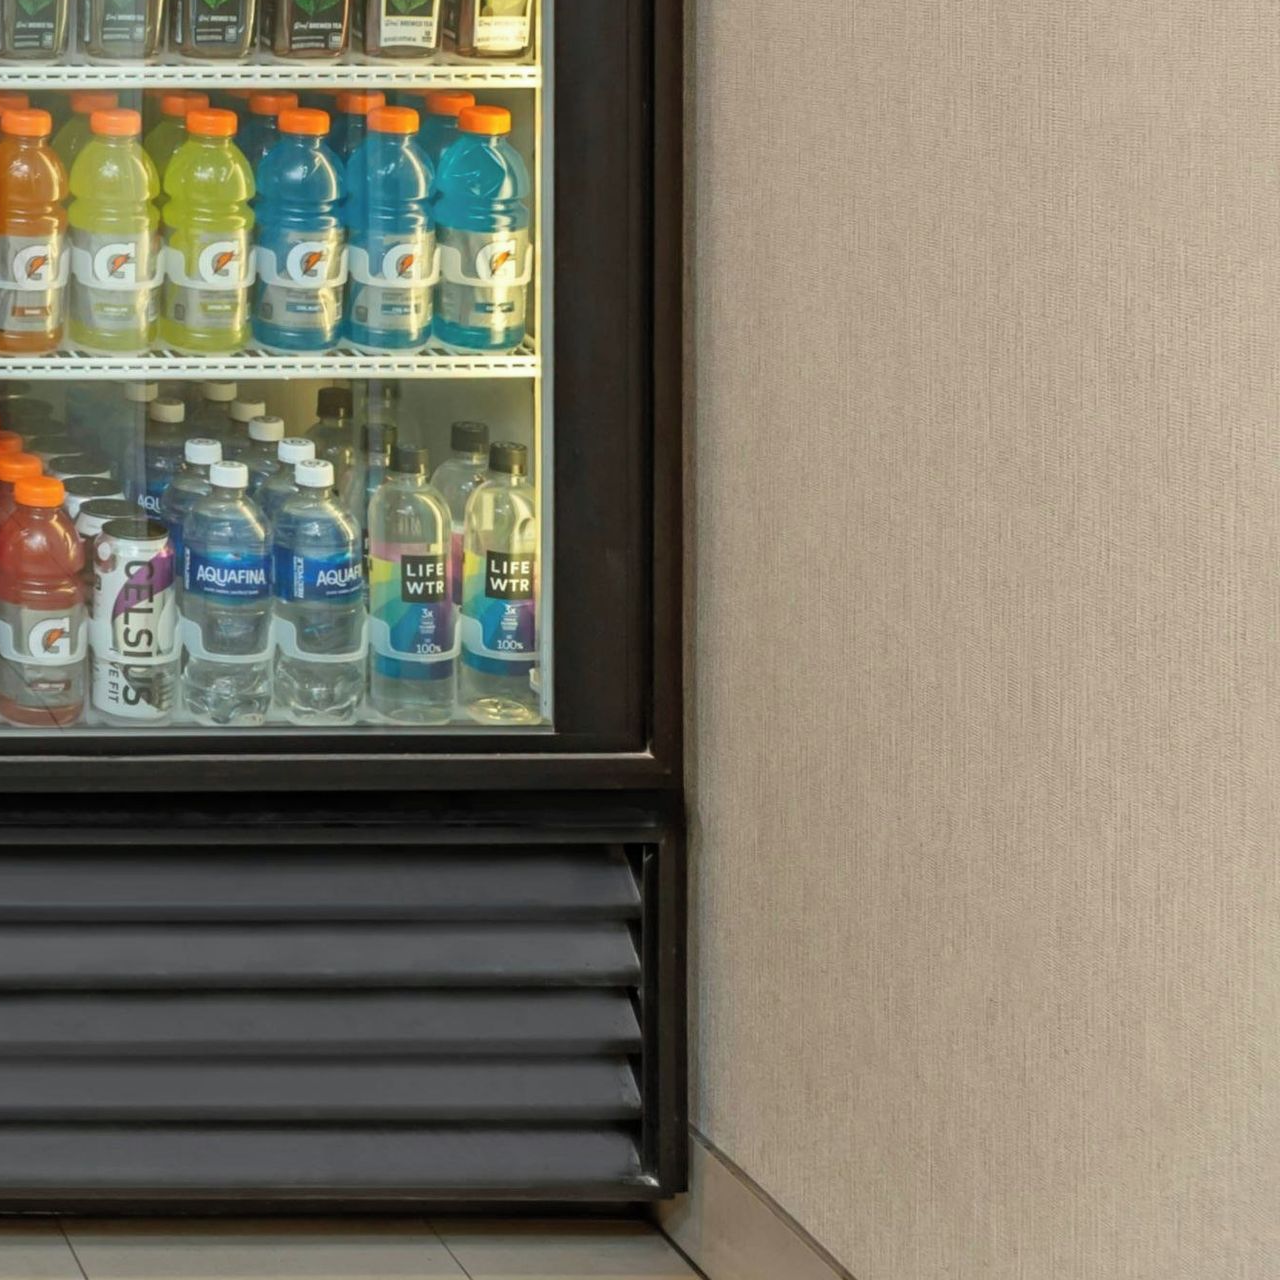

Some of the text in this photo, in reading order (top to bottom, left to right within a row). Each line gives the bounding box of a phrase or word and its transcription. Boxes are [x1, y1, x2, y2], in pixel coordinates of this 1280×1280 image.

[11, 244, 54, 287] G
[93, 242, 137, 284] G
[198, 242, 240, 287] G
[197, 566, 266, 586] AQUAFINA
[406, 563, 444, 576] LIFE
[490, 561, 530, 574] LIFE
[406, 580, 444, 595] WTR
[490, 578, 530, 592] WTR
[28, 618, 70, 657] G
[122, 560, 154, 706] CELSIUS
